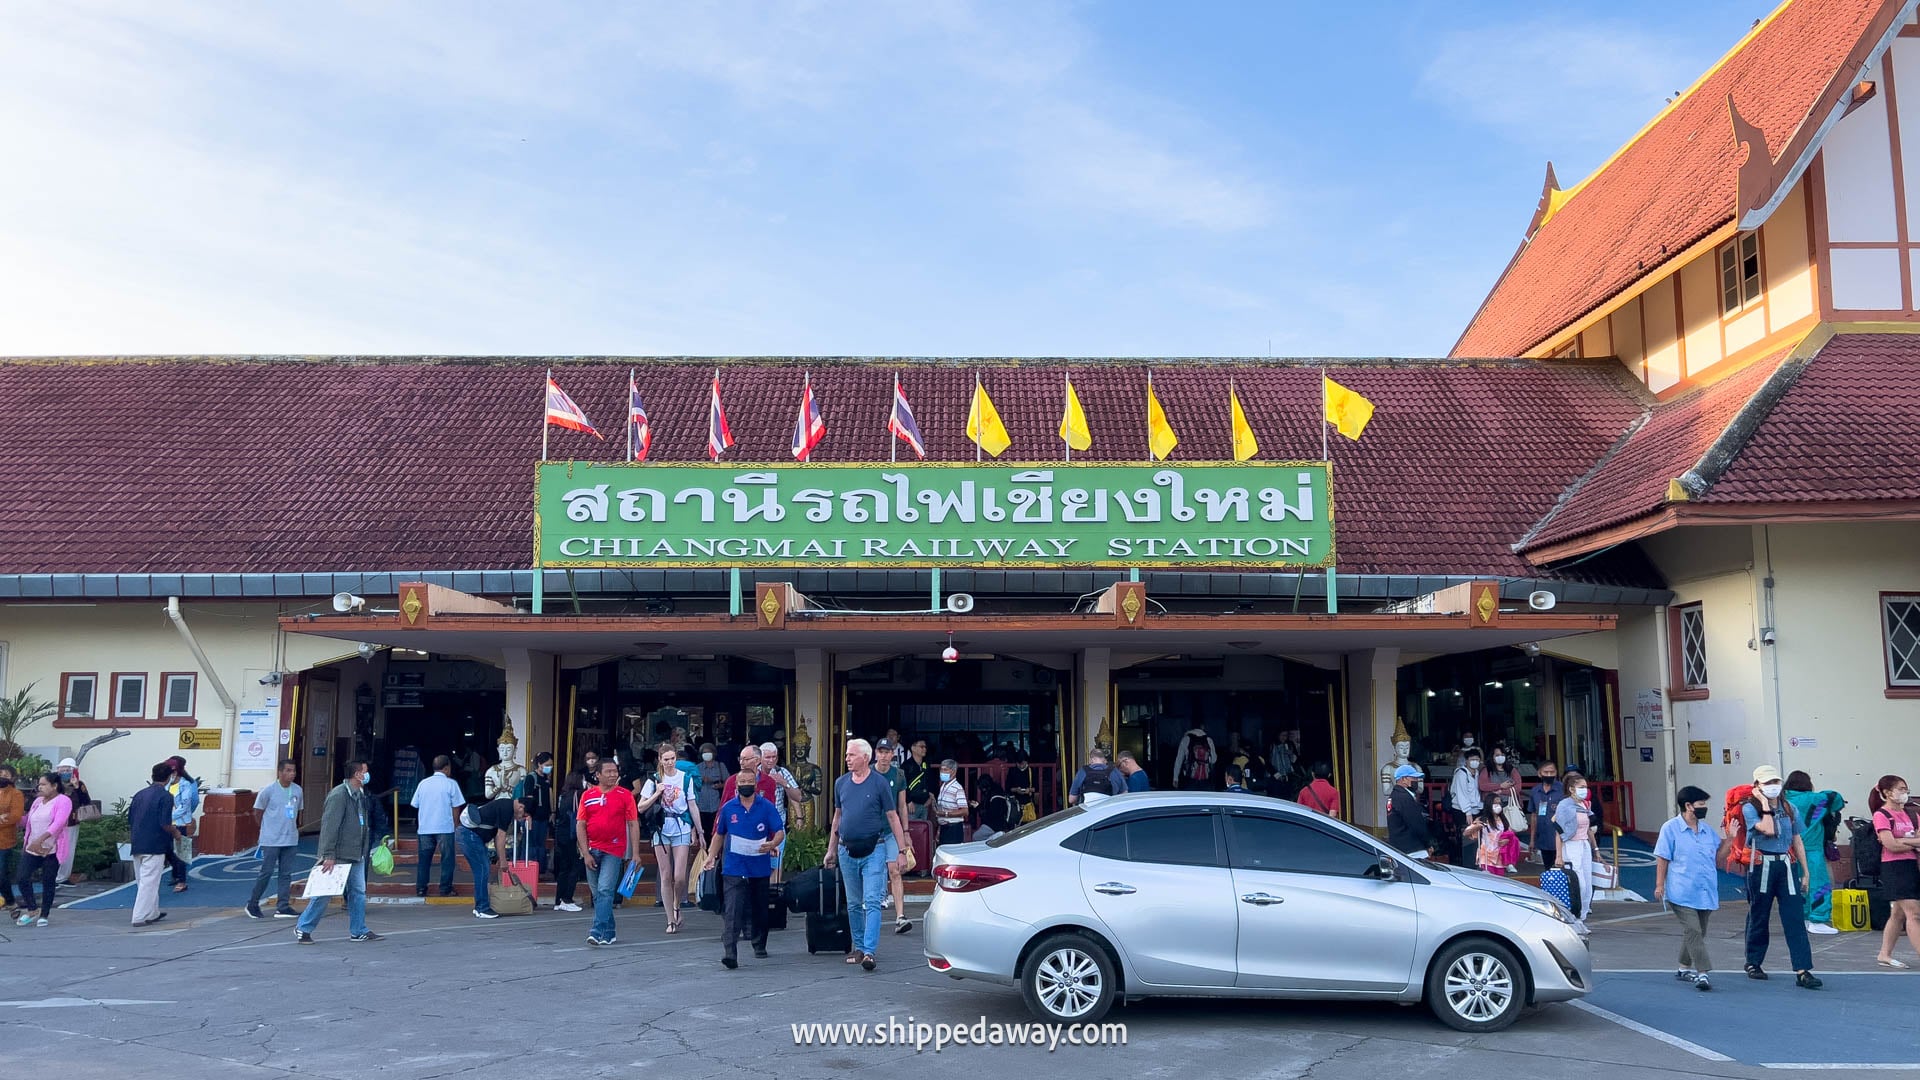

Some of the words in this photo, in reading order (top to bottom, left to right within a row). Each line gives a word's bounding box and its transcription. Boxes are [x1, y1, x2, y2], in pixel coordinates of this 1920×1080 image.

[562, 471, 1314, 523] สถานีรถไฟเชียงใหม่
[559, 537, 846, 558] CHIANGMAI
[860, 537, 1079, 558] RAILWAY
[1107, 537, 1313, 557] STATION
